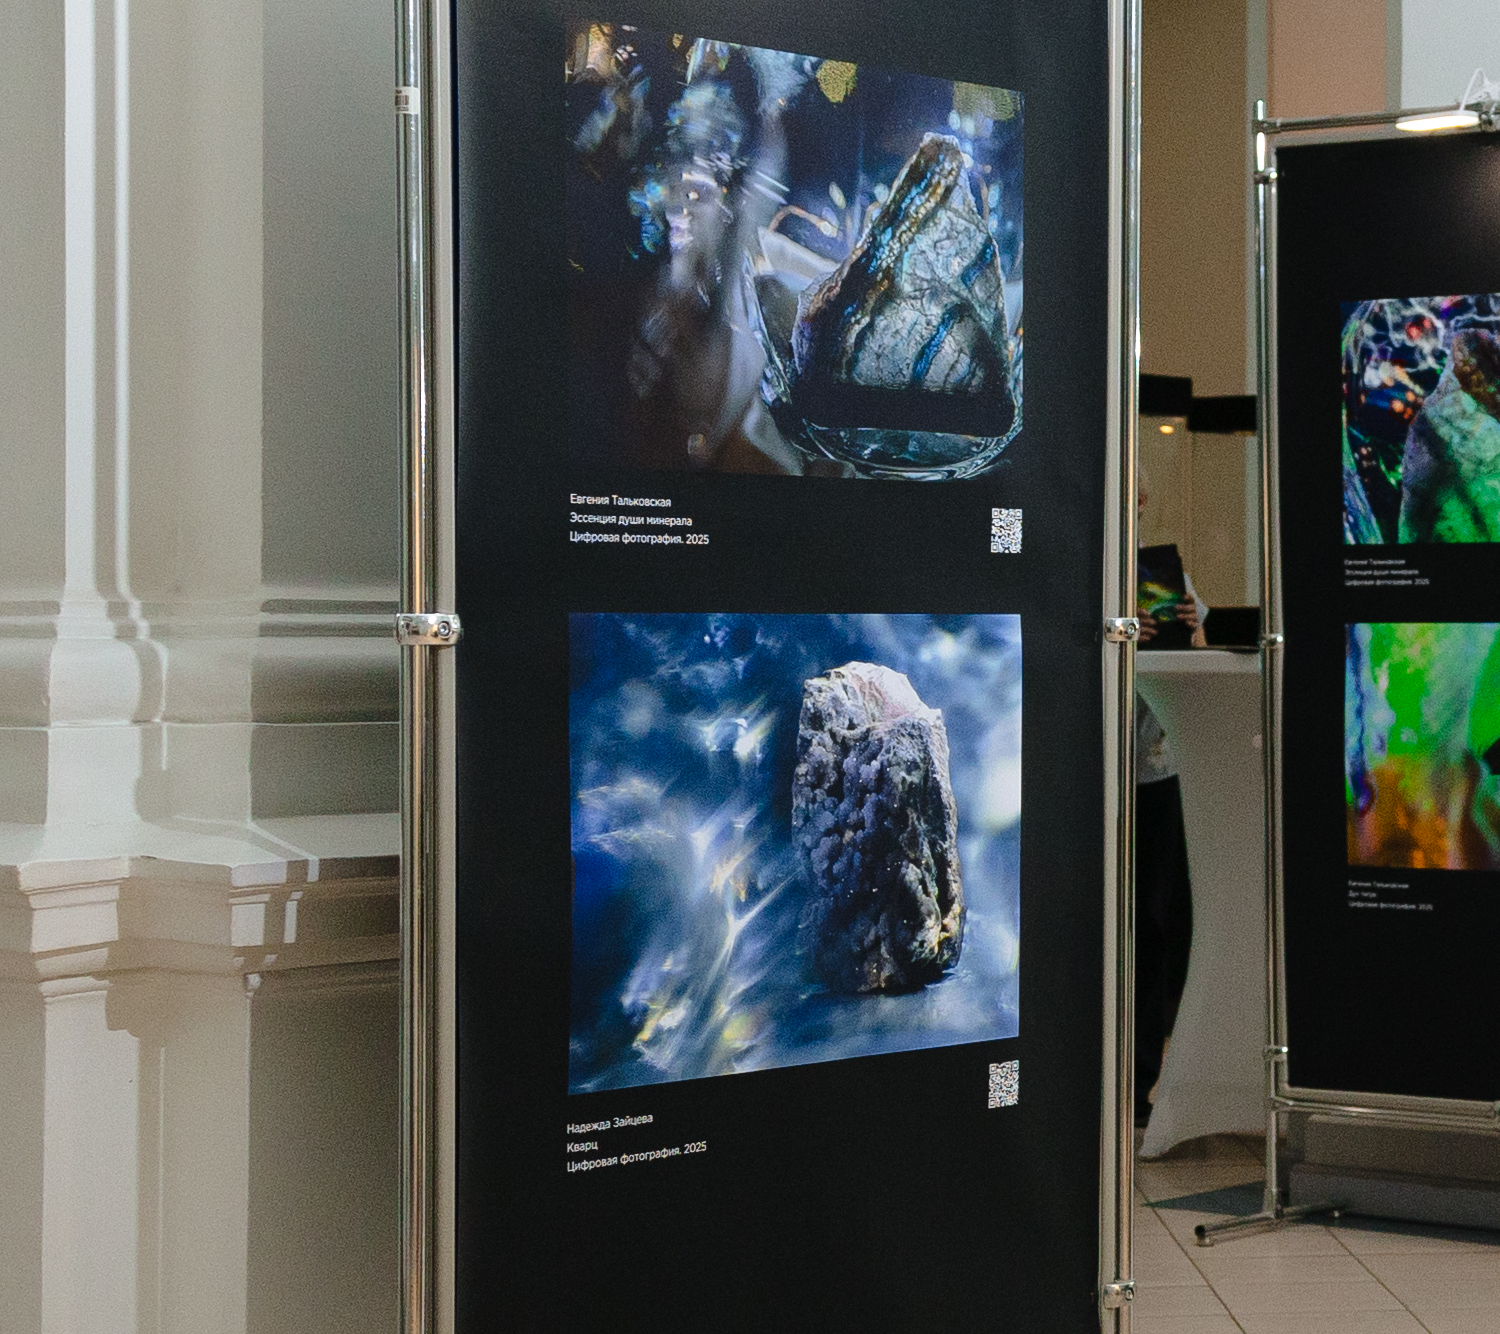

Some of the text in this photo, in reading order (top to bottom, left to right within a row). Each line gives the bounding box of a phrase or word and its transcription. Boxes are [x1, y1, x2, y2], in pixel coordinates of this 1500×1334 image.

[570, 493, 671, 507] Евгения Тальковская
[570, 512, 692, 527] Эссенция души минерала
[570, 531, 709, 545] Цифровая фотография. 2025
[567, 1114, 653, 1134] Надежда Зайцева
[567, 1141, 598, 1153] Кварц
[567, 1141, 707, 1173] Цифровая фотография. 2025
